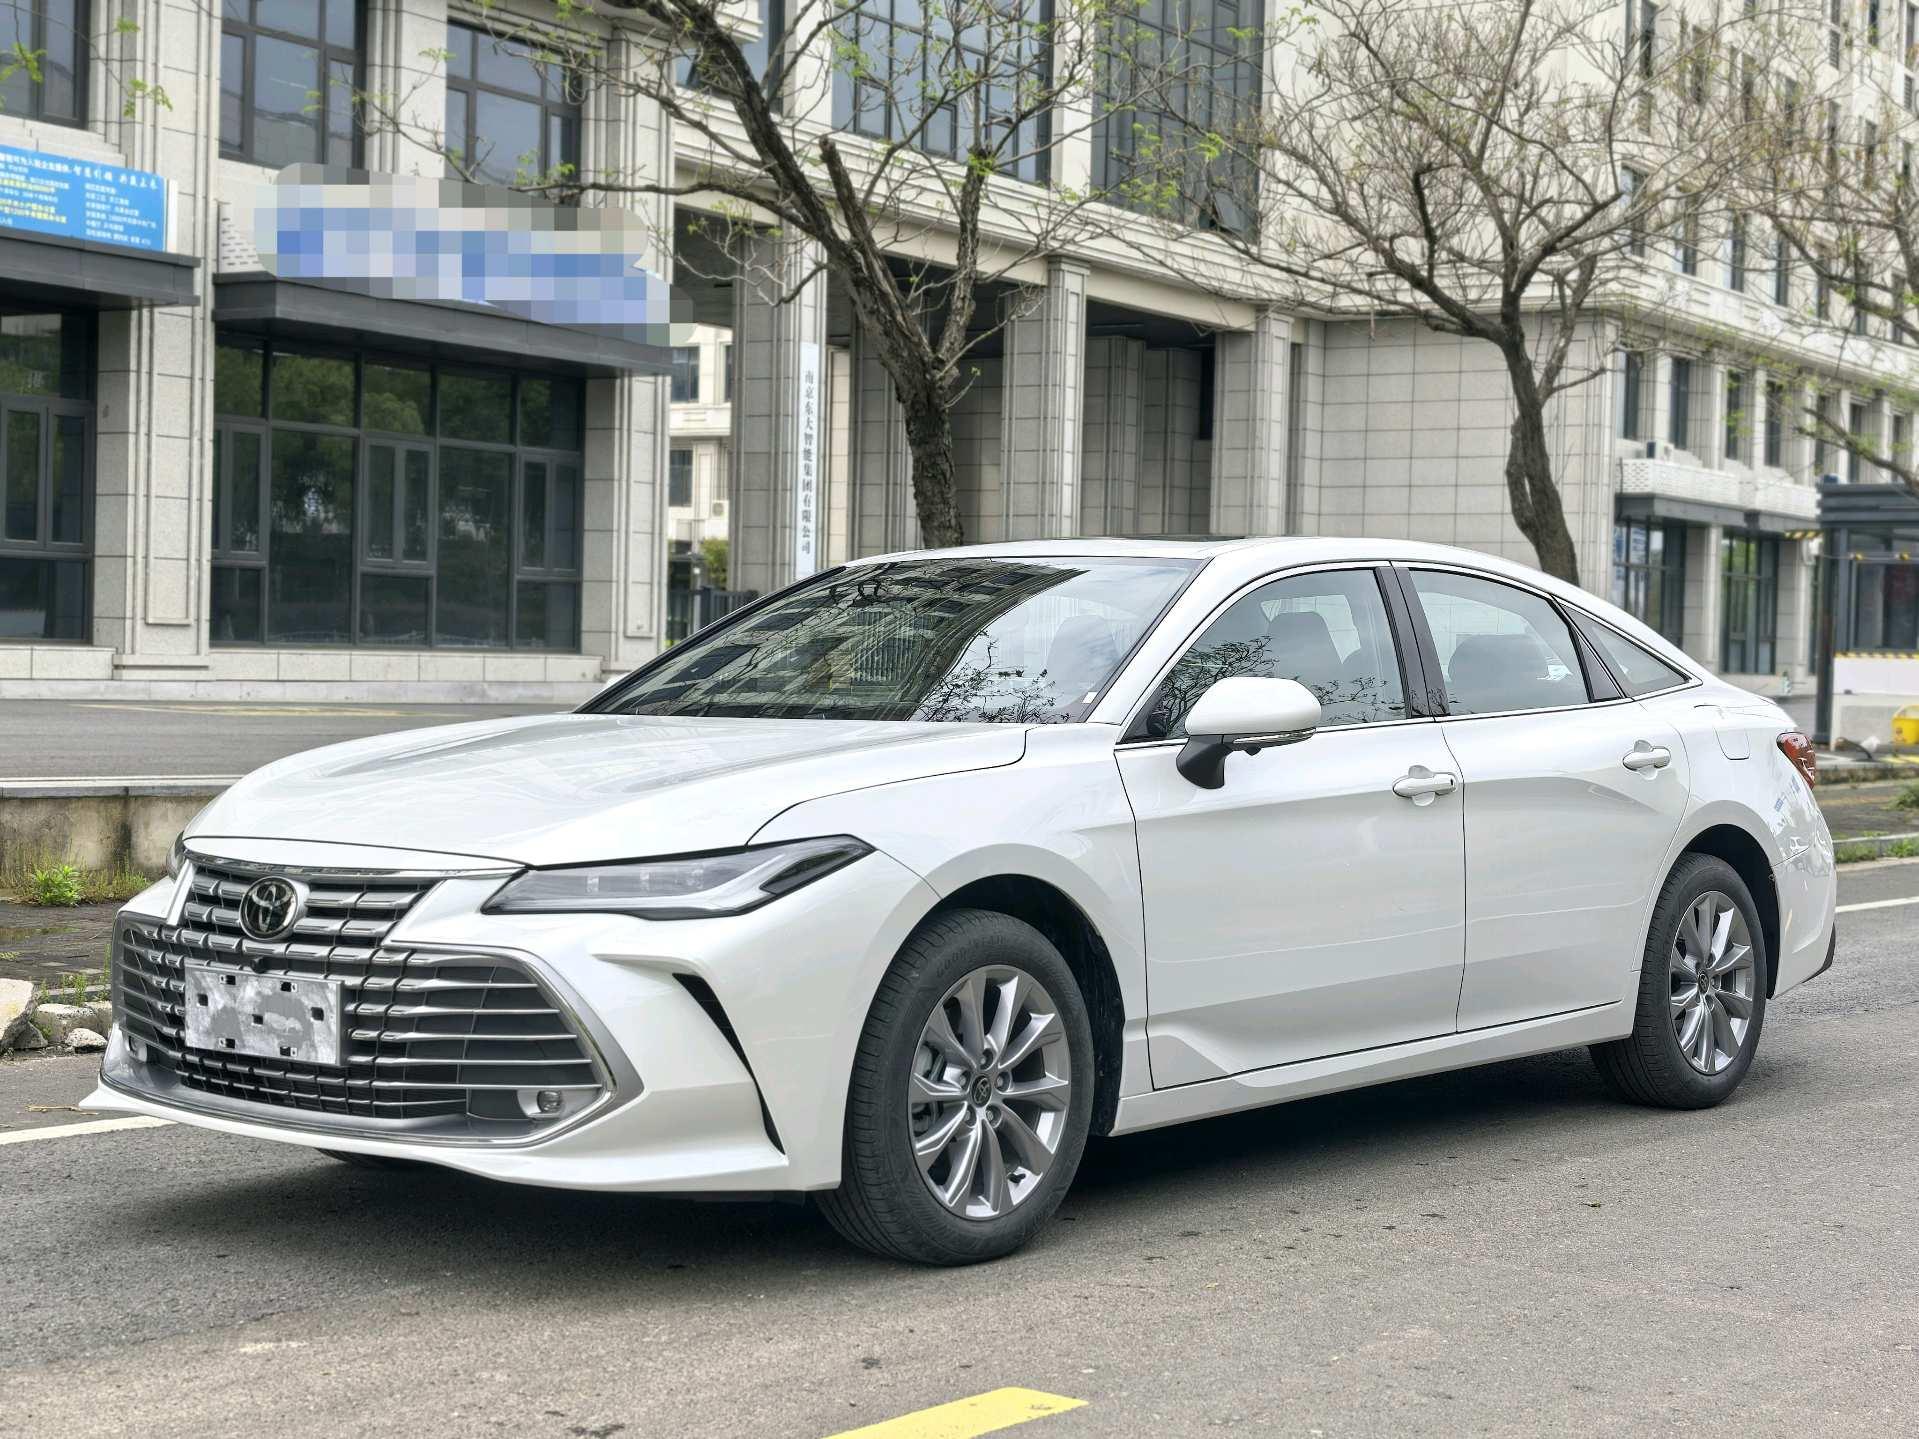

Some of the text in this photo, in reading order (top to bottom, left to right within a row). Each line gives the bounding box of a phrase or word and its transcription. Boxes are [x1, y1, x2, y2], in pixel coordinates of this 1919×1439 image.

[801, 369, 815, 555] 南京东大智能集团有限公司
